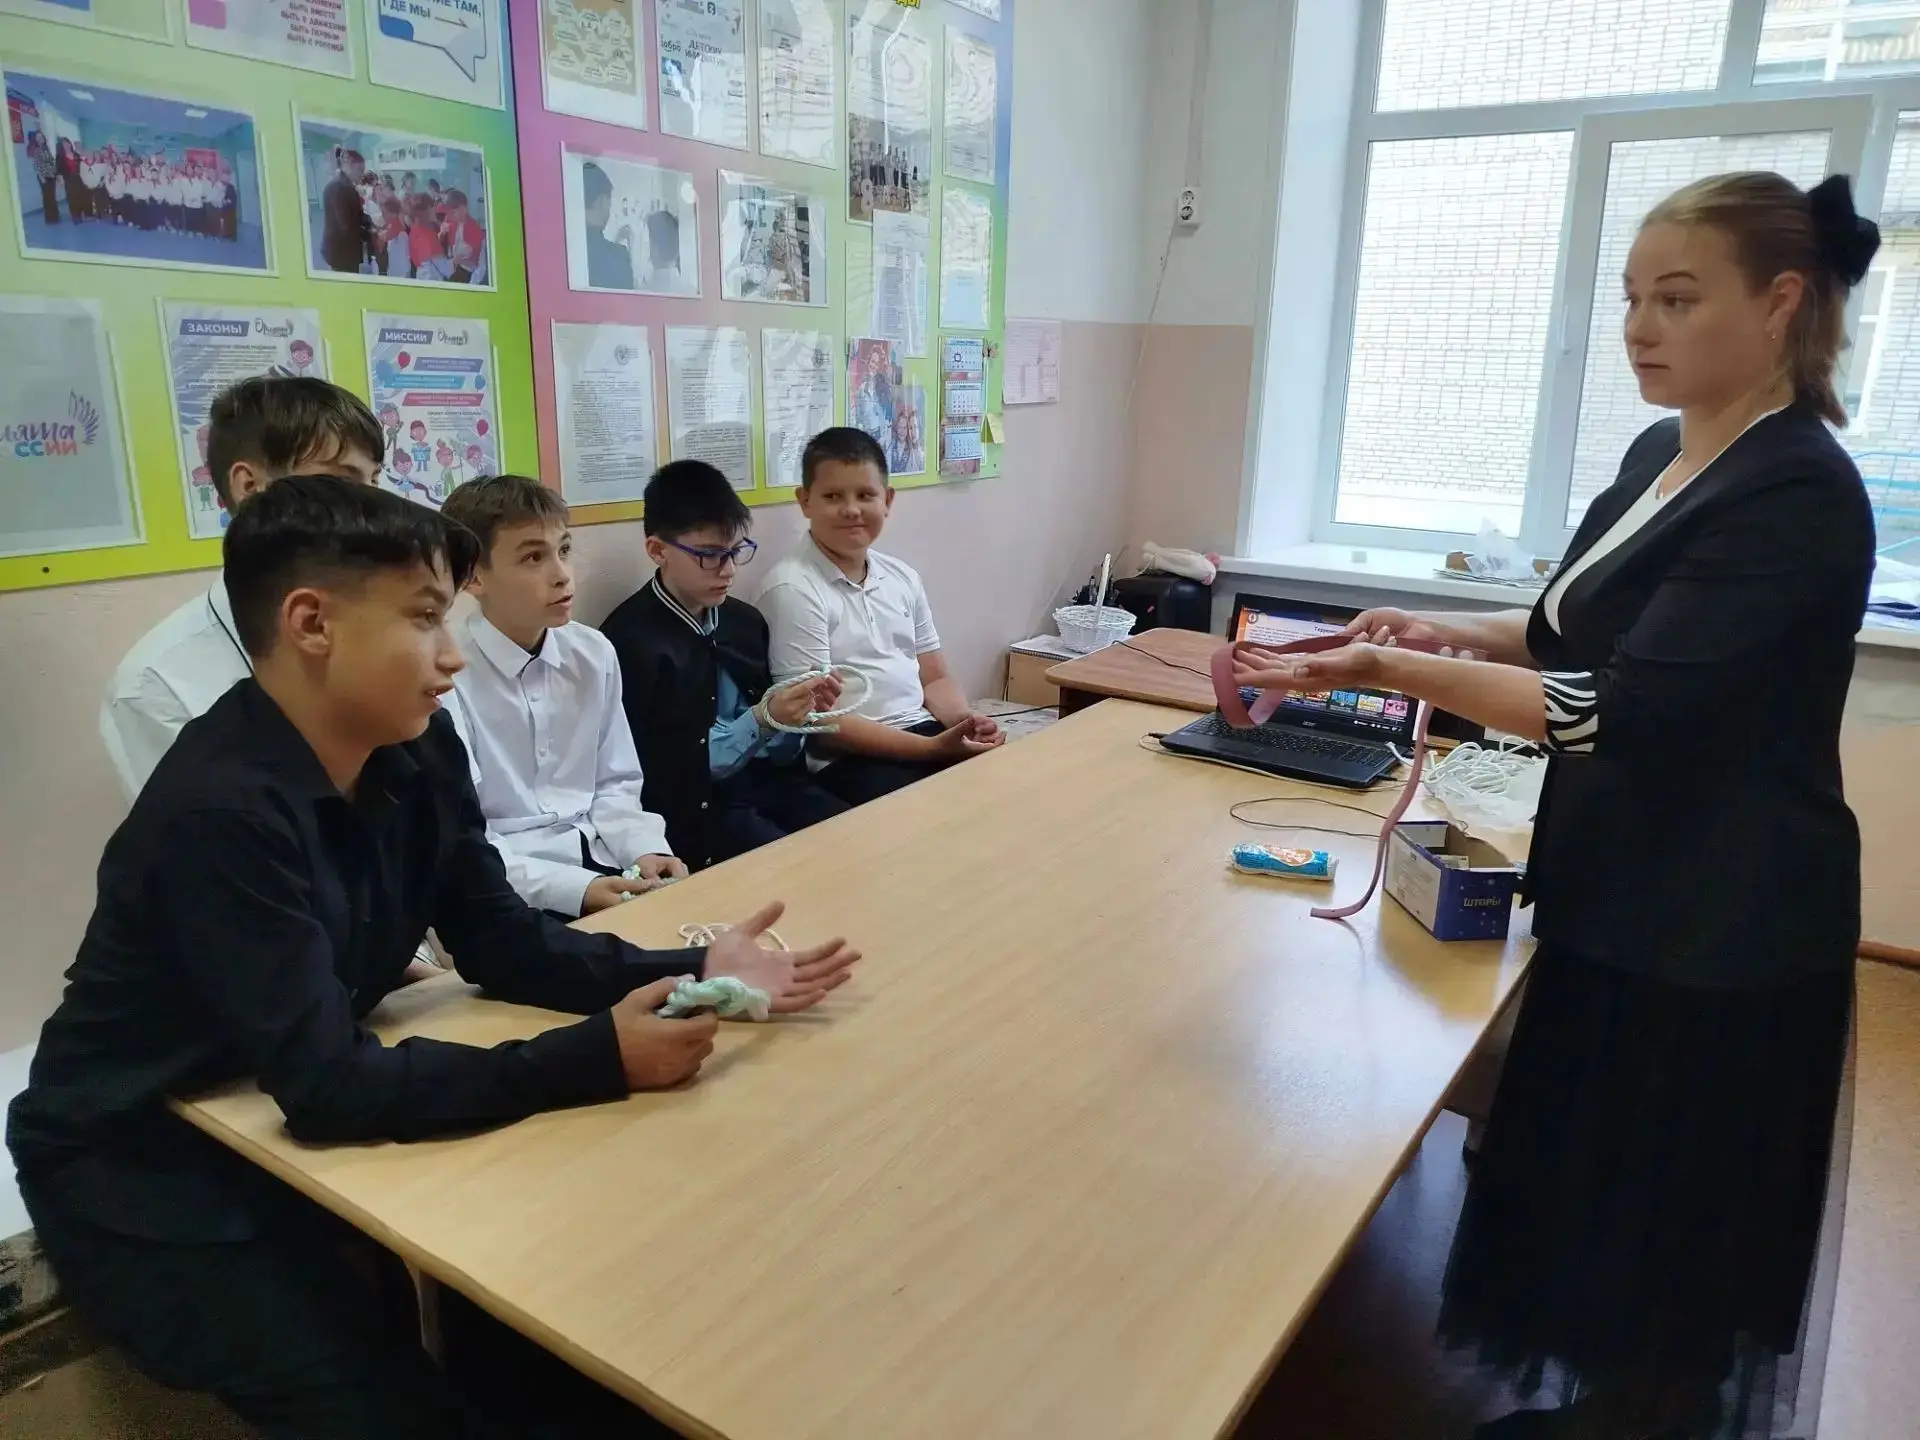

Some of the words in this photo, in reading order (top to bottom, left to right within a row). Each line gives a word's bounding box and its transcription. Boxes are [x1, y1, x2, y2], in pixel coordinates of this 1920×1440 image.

[409, 3, 431, 18] МЫ
[456, 0, 481, 17] ТАМ,
[187, 322, 242, 335] ЗАКОНЫ
[384, 331, 428, 342] МИССИИ
